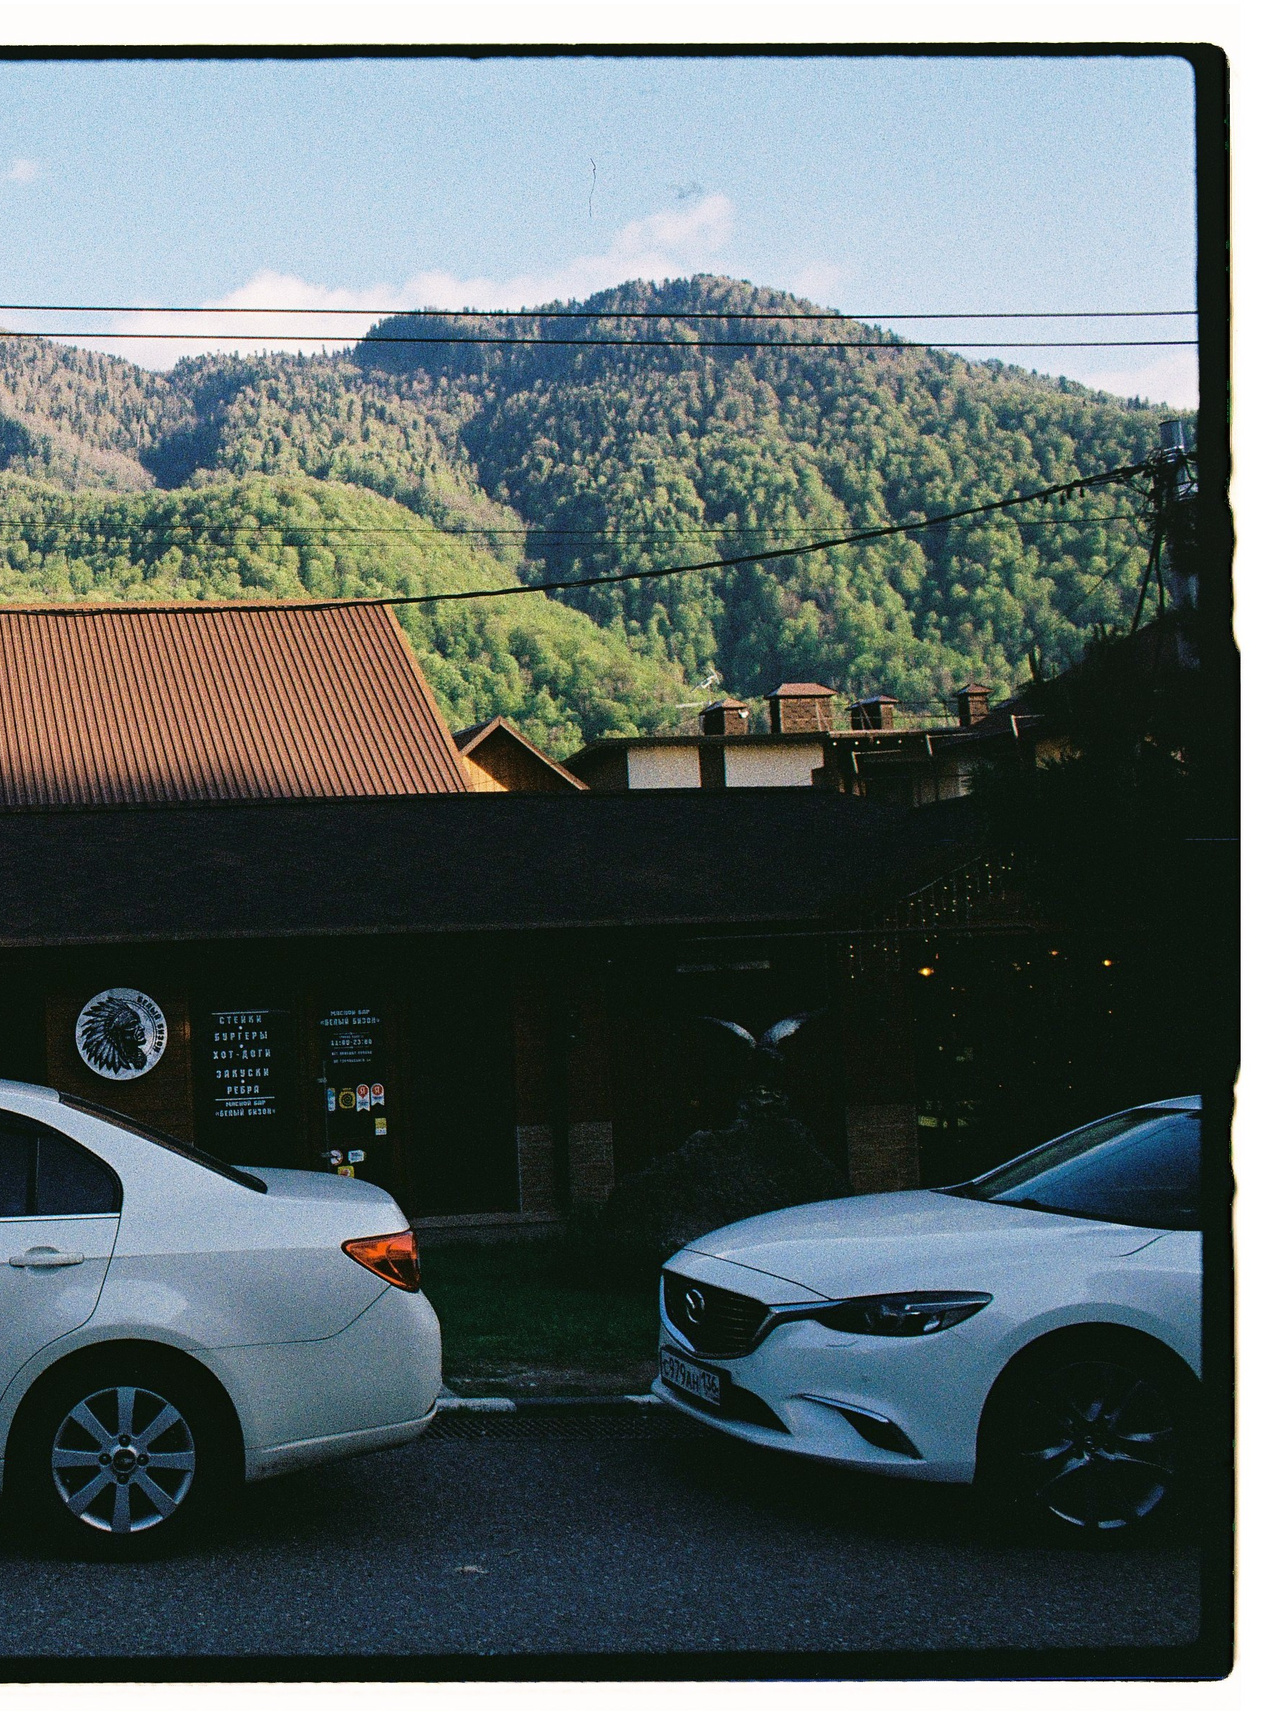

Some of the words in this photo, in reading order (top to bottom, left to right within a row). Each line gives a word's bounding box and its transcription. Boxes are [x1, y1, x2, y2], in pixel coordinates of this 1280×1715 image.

[219, 1014, 262, 1025] СТЕЙКИ
[214, 1031, 268, 1042] БУРГЕРЫ
[213, 1048, 271, 1060] ХОТ-ДОГИ
[216, 1068, 269, 1079] ЗАКУСКИ
[227, 1085, 260, 1095] РЕБРА
